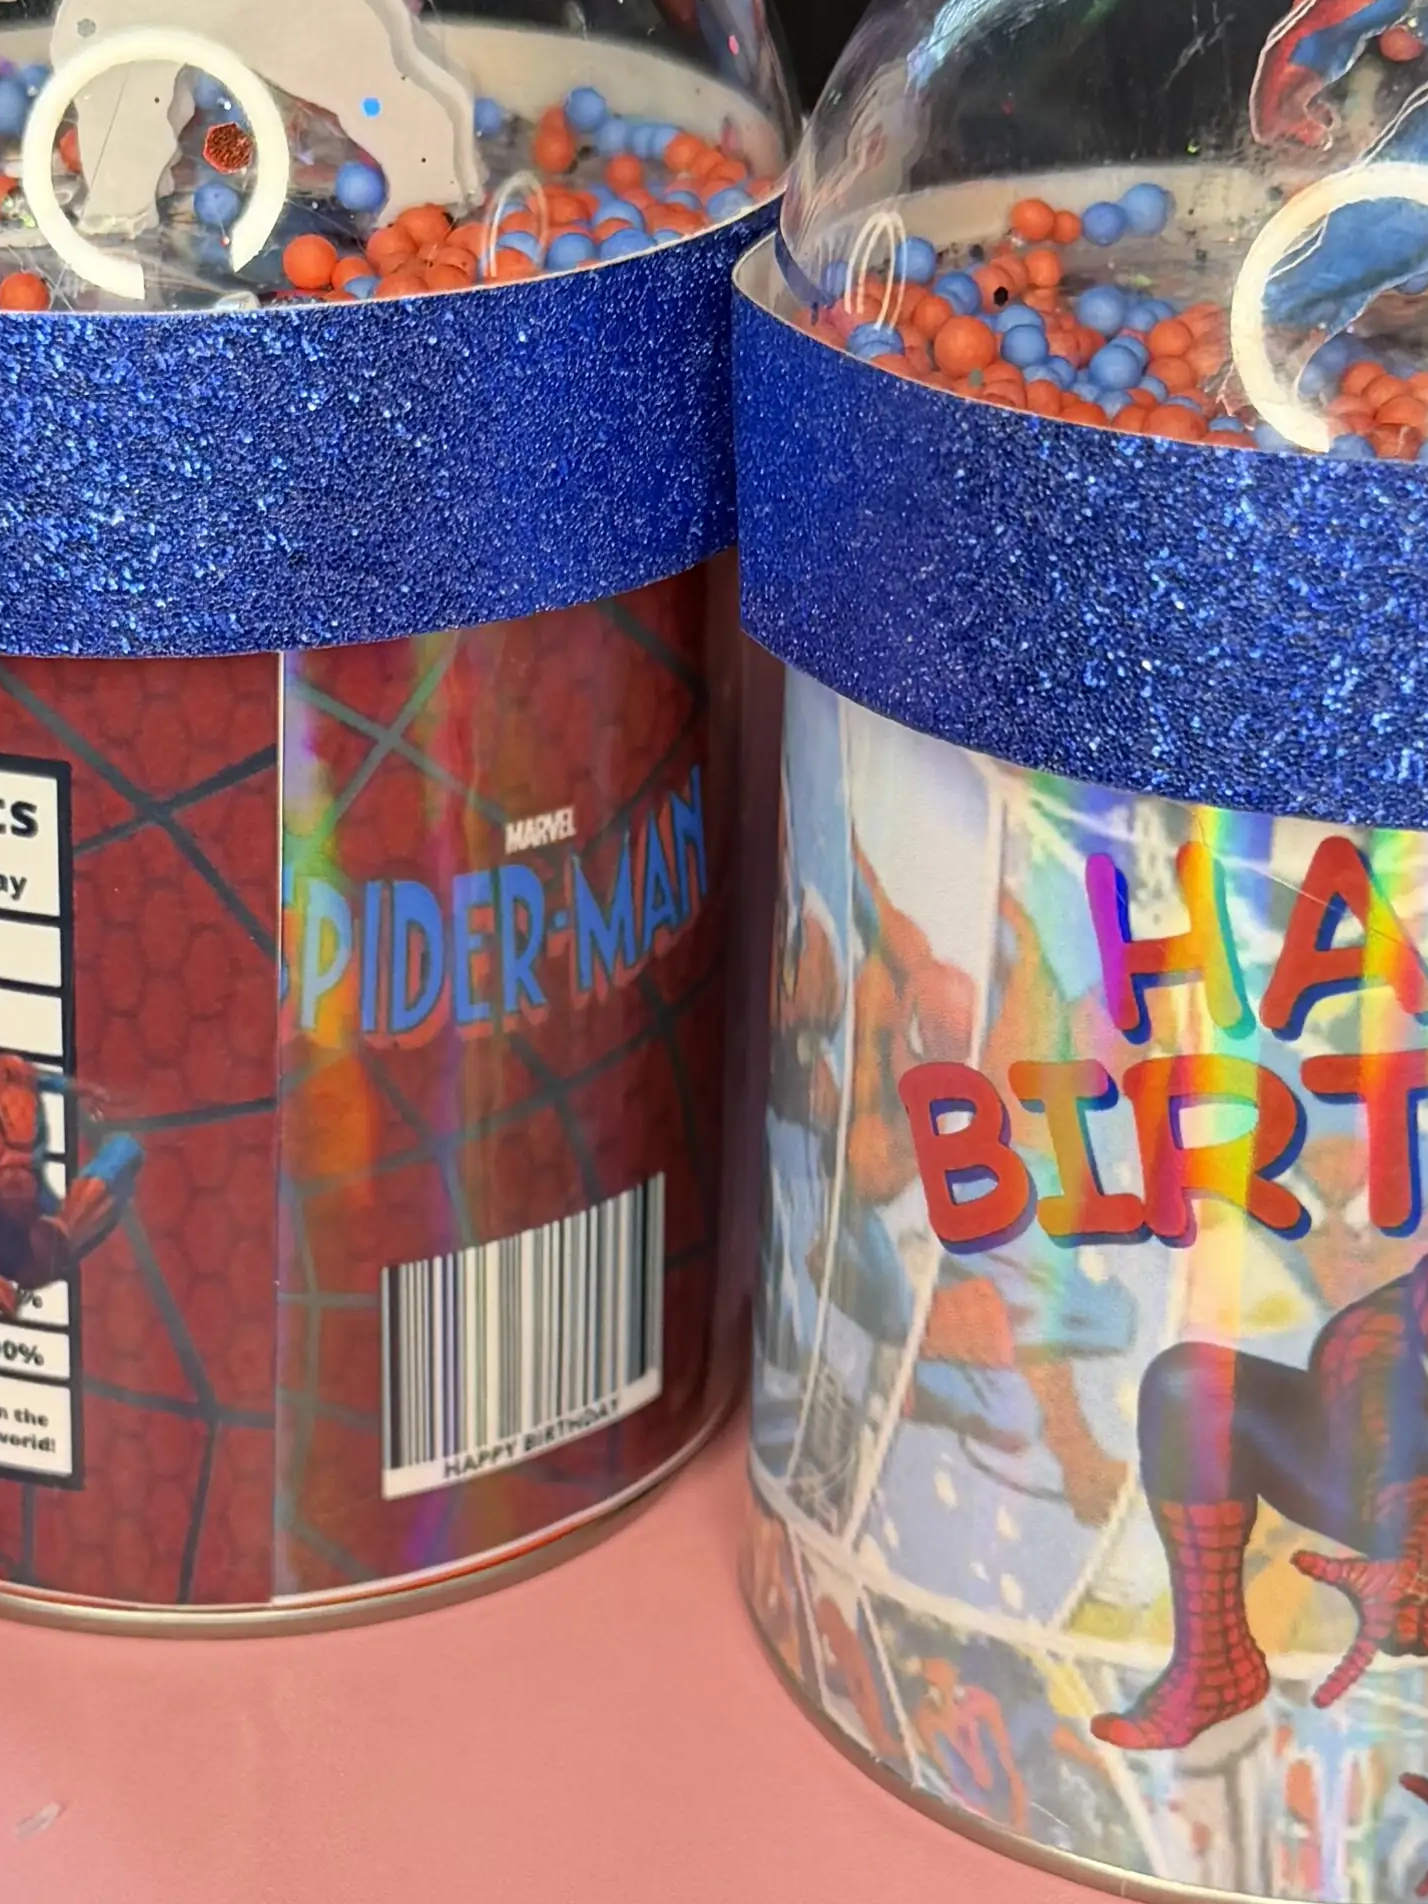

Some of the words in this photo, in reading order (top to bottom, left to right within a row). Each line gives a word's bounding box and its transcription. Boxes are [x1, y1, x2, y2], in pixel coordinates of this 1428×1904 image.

[505, 805, 577, 856] MARVEL
[13, 1405, 50, 1428] the
[442, 1440, 518, 1480] HAPPY
[522, 1396, 620, 1453] BIRTHDAY
